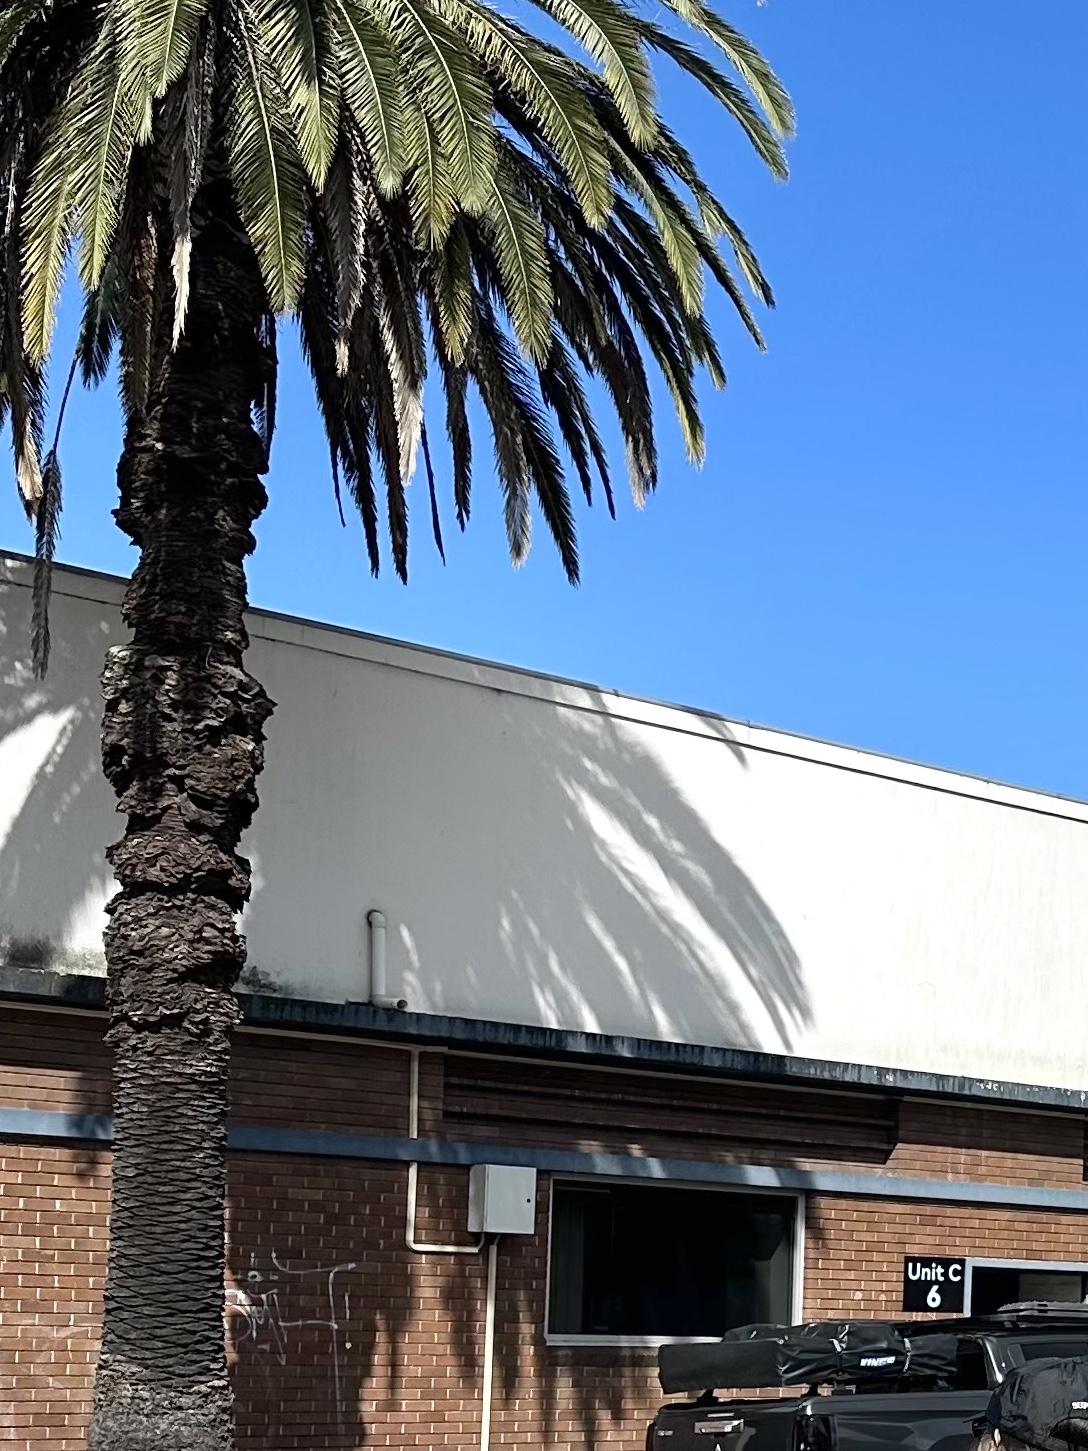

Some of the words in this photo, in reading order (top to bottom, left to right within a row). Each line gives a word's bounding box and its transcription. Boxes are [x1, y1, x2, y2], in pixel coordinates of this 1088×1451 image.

[908, 1261, 945, 1282] Unit
[948, 1263, 962, 1282] C
[926, 1284, 941, 1309] 6
